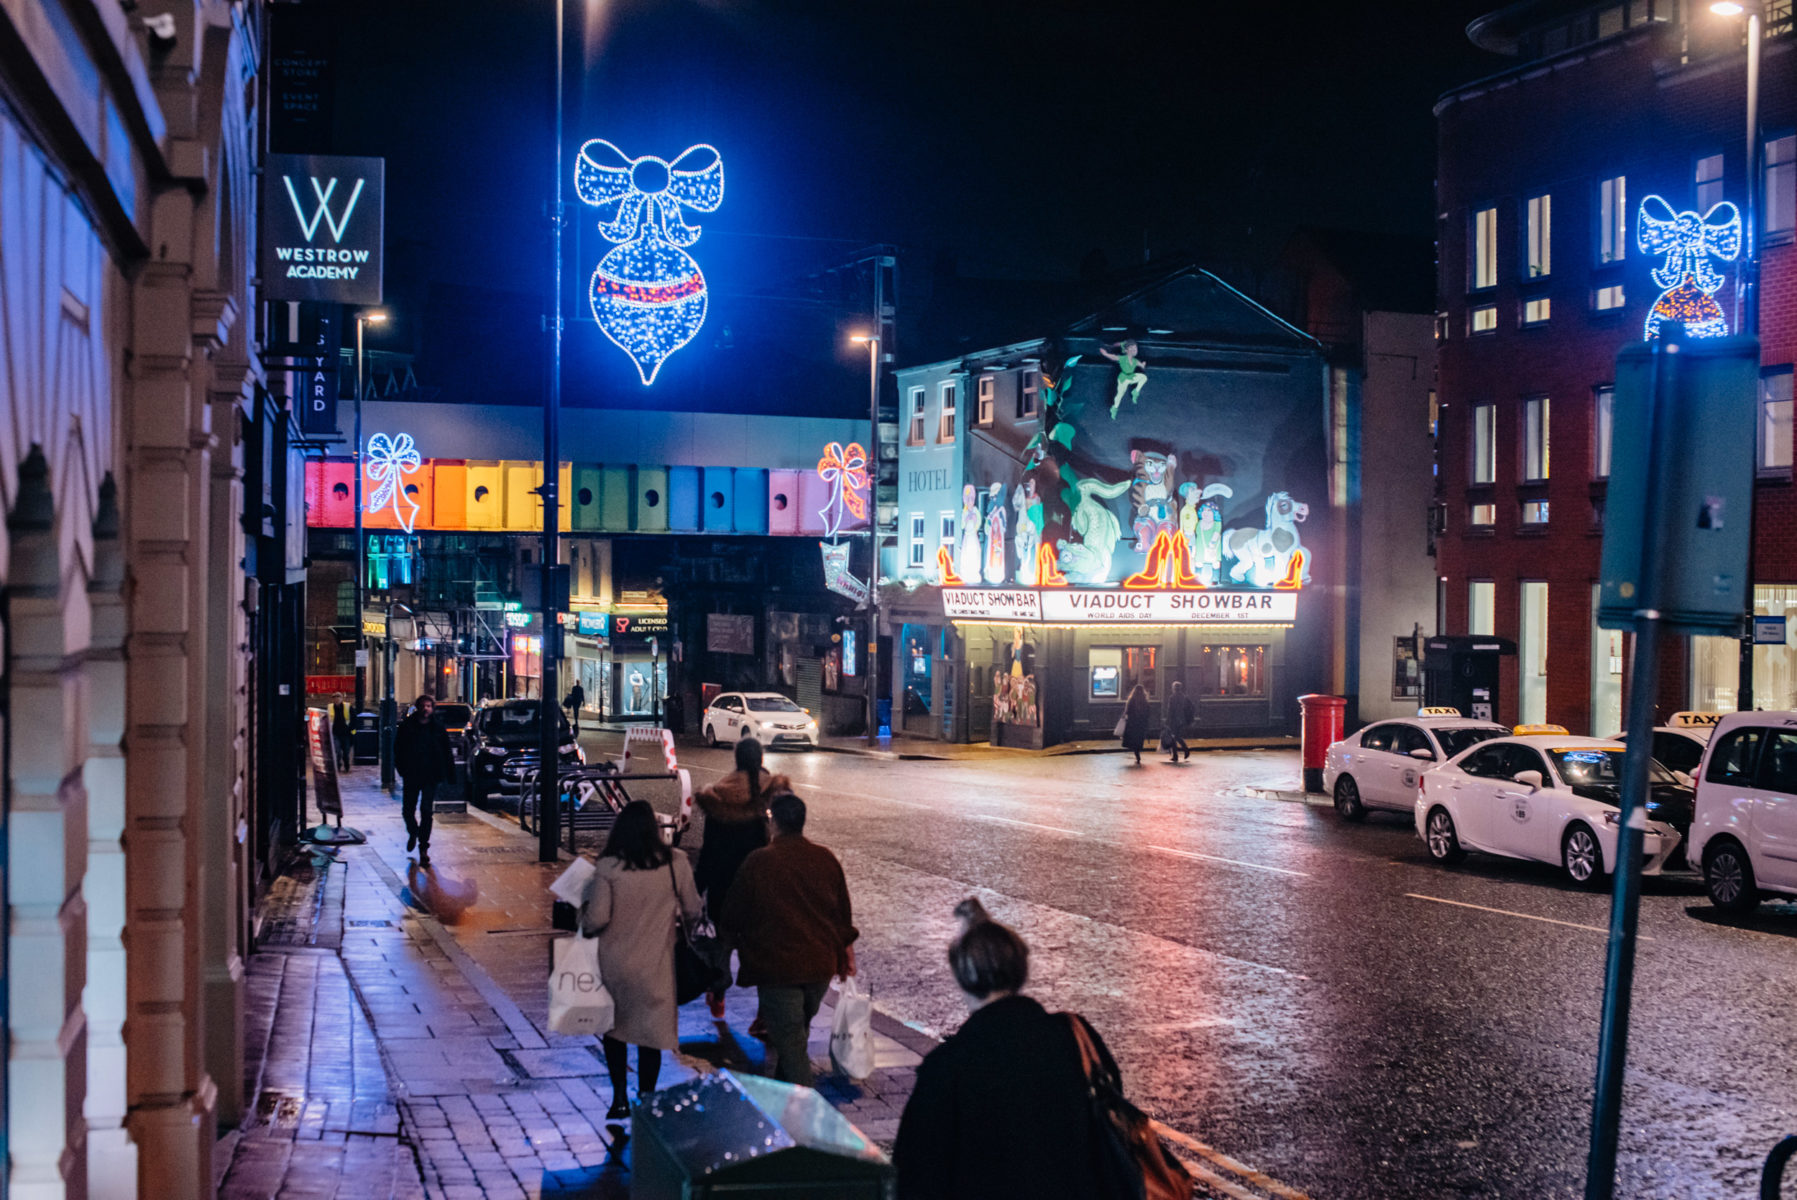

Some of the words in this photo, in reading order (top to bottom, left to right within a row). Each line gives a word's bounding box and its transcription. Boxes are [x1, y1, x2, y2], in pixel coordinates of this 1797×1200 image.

[282, 102, 319, 111] SPACE
[276, 247, 370, 263] WESTROW
[286, 264, 360, 280] ACADEMY
[313, 356, 326, 412] YARD
[908, 469, 951, 492] HOTEL
[944, 592, 985, 606] VIADUCT
[1069, 594, 1155, 609] VIADUCT
[1170, 594, 1272, 609] SHOWBAR
[637, 617, 668, 625] LICENSED
[1424, 707, 1457, 715] TAXI
